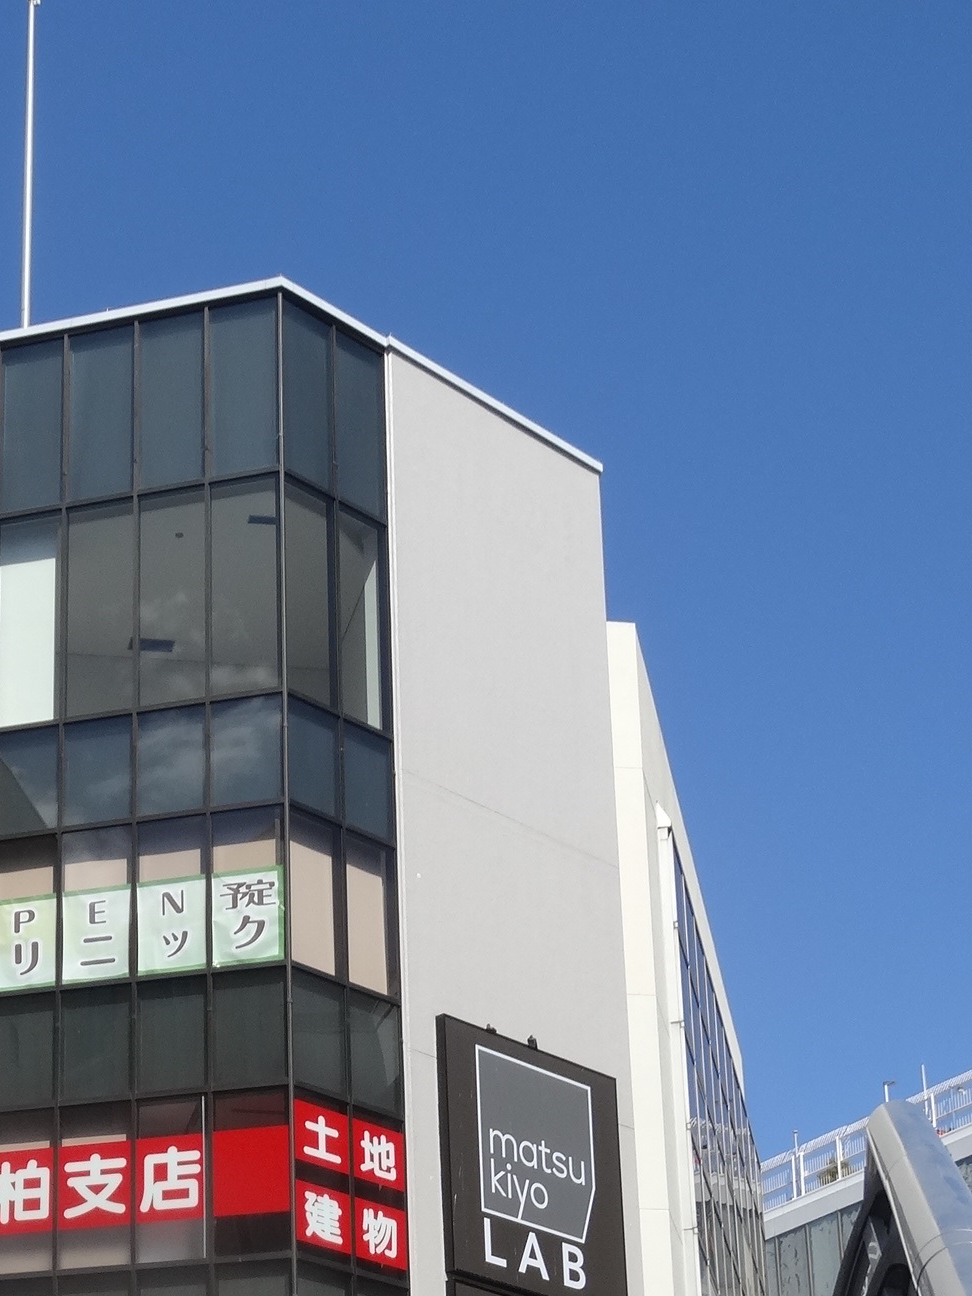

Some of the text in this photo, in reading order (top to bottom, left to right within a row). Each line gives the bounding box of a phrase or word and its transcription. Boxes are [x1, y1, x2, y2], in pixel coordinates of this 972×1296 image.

[303, 1116, 397, 1181] 土地
[489, 1128, 586, 1186] matsu
[490, 1158, 549, 1220] kiyo
[304, 1191, 398, 1259] 建物
[483, 1217, 586, 1290] LAB
